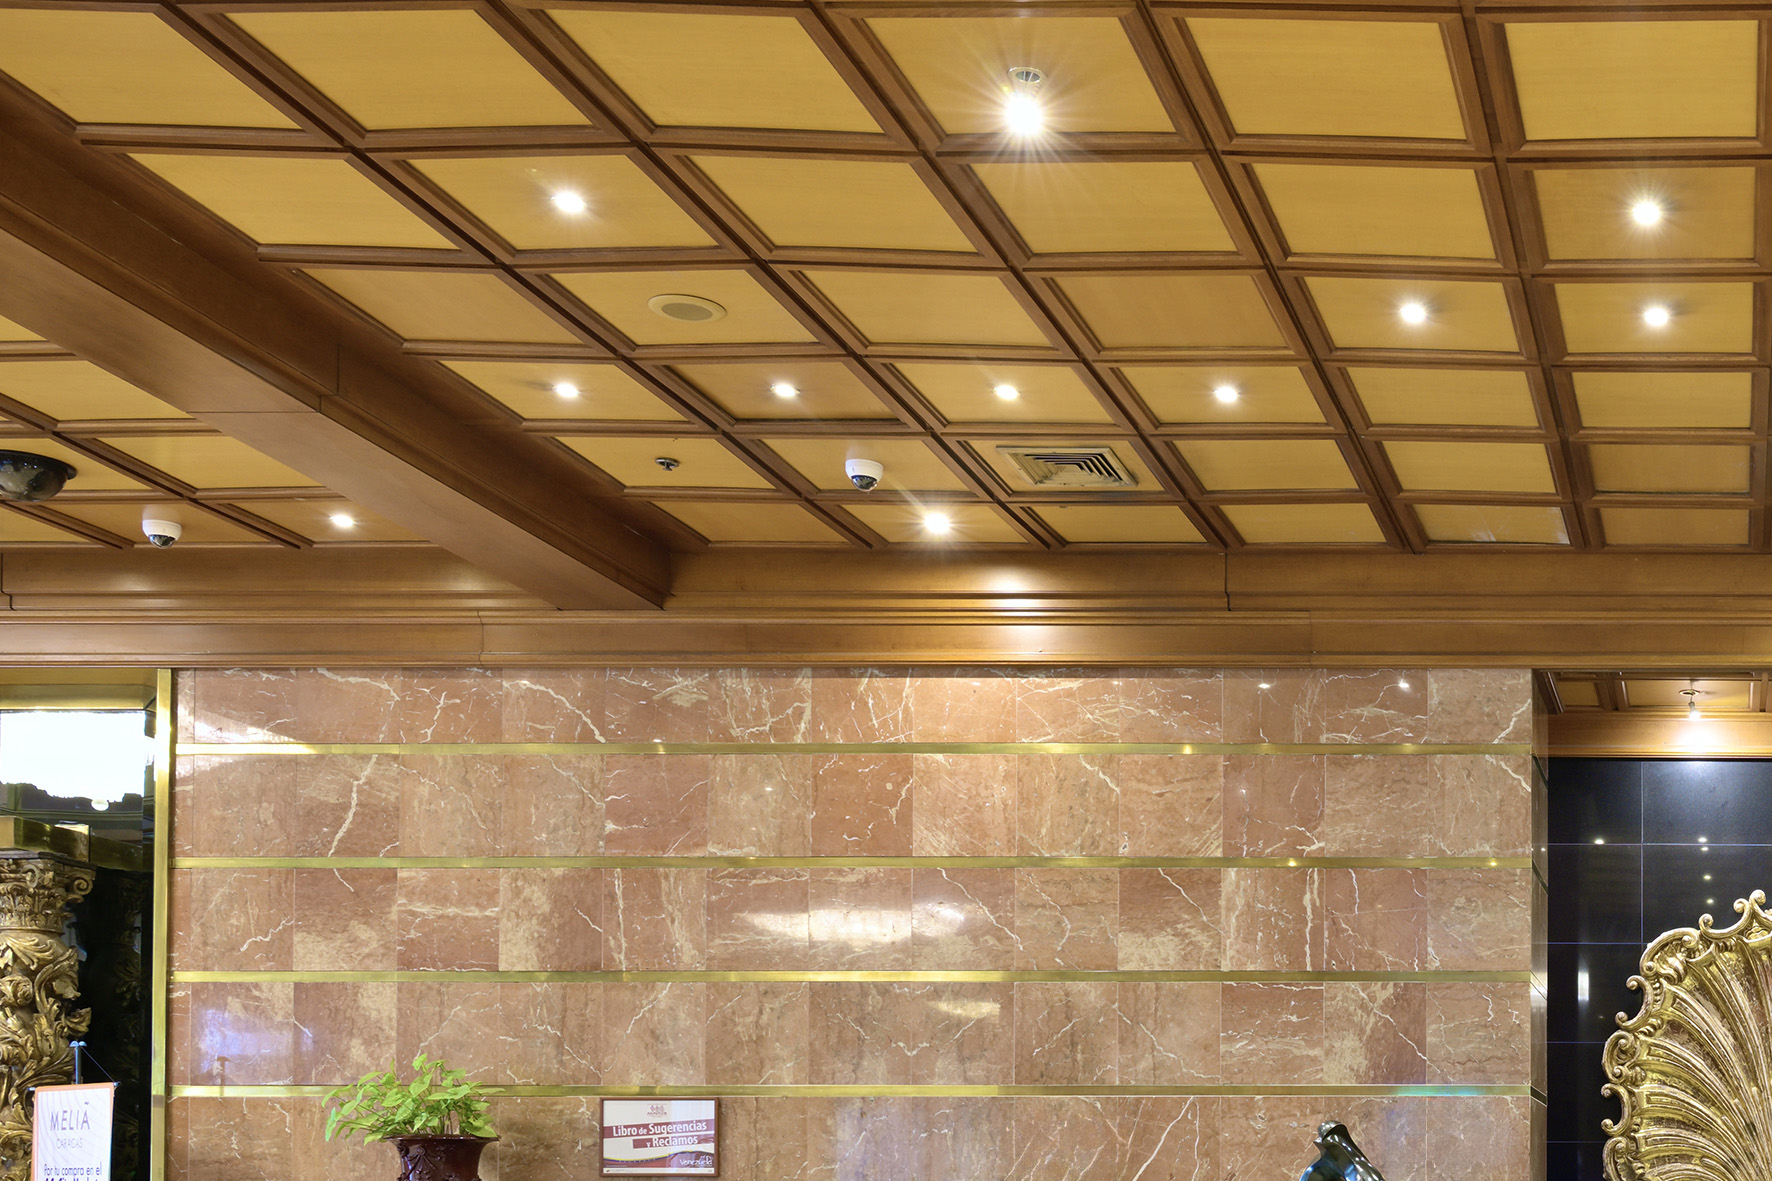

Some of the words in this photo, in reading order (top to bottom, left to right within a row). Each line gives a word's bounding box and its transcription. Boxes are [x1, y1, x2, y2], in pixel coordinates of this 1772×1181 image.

[613, 1125, 637, 1137] Libro
[638, 1127, 647, 1135] de
[648, 1121, 707, 1135] Sugerencias
[652, 1136, 698, 1148] Reclamos
[679, 1155, 713, 1166] Venezuela
[44, 1163, 53, 1176] Por
[54, 1165, 60, 1176] tu
[62, 1167, 84, 1178] compra
[86, 1167, 94, 1176] en
[96, 1161, 102, 1176] el
